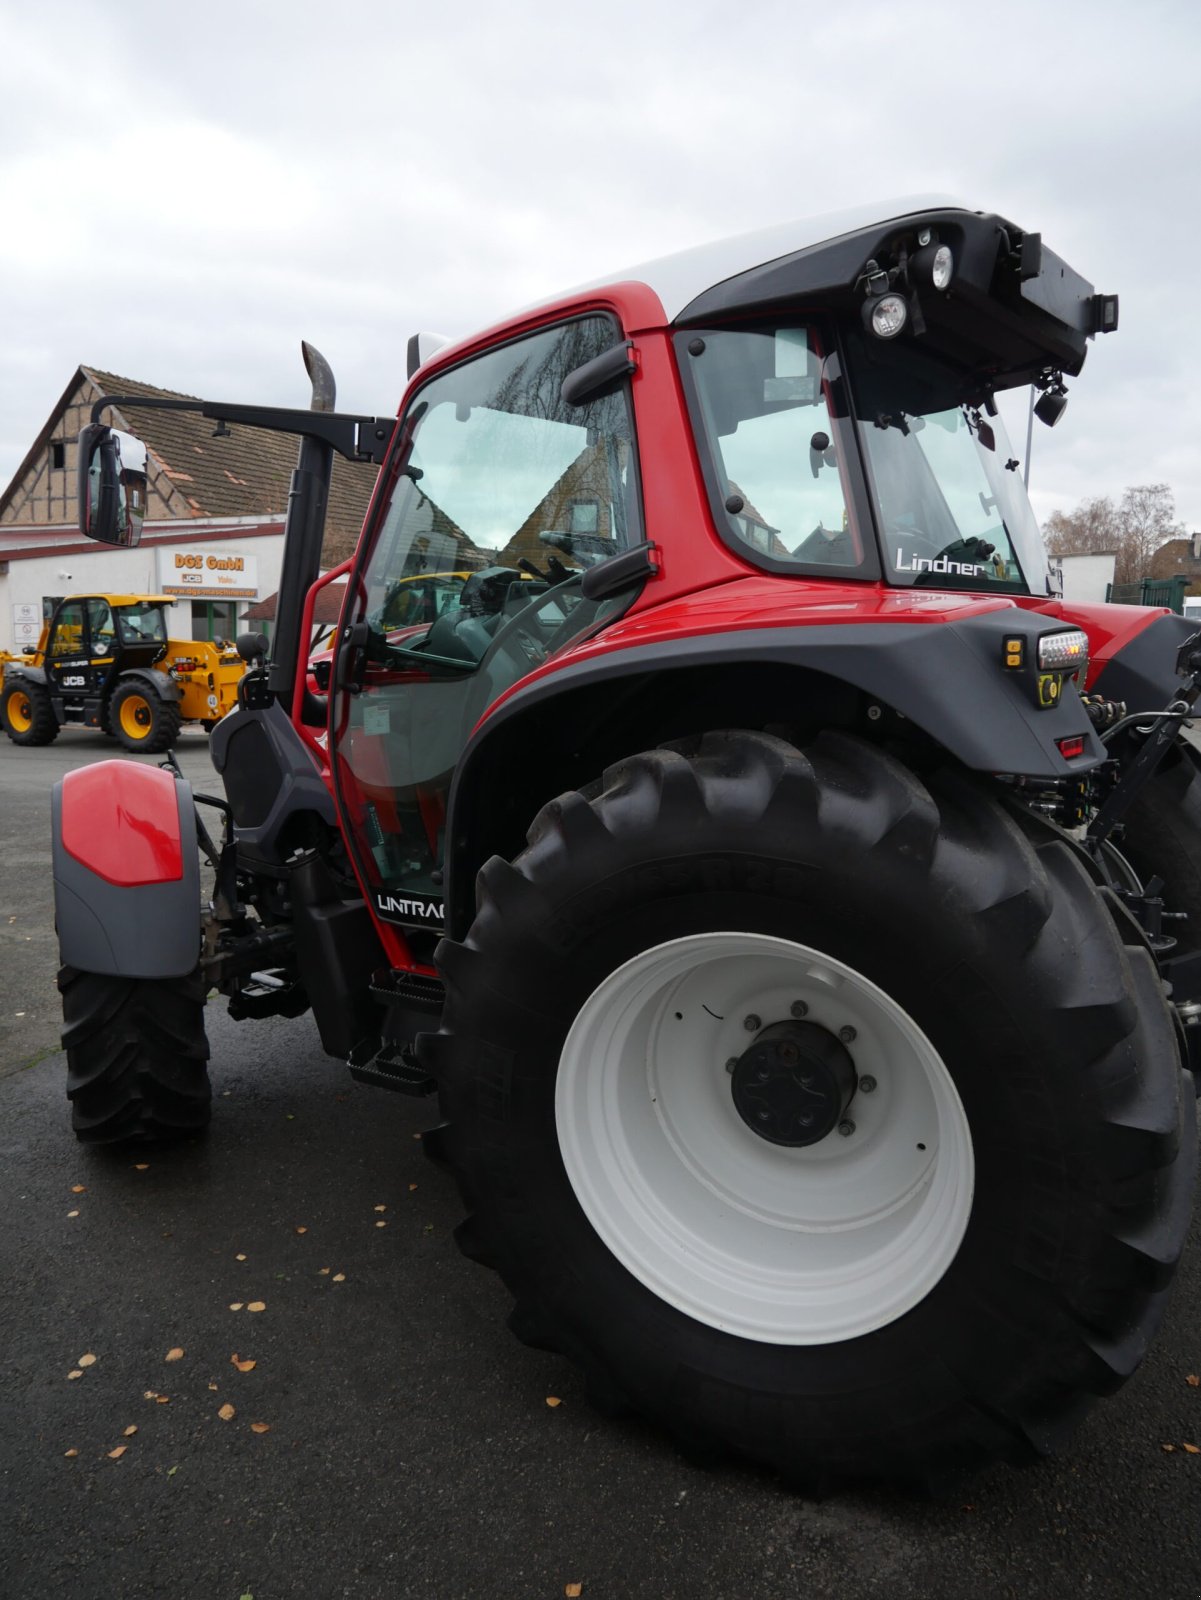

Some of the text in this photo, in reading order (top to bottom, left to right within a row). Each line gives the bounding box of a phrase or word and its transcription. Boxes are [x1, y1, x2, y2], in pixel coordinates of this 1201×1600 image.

[175, 554, 203, 569] DGS
[896, 548, 985, 577] Lindner
[183, 575, 202, 583] JCB
[63, 676, 85, 686] JCB
